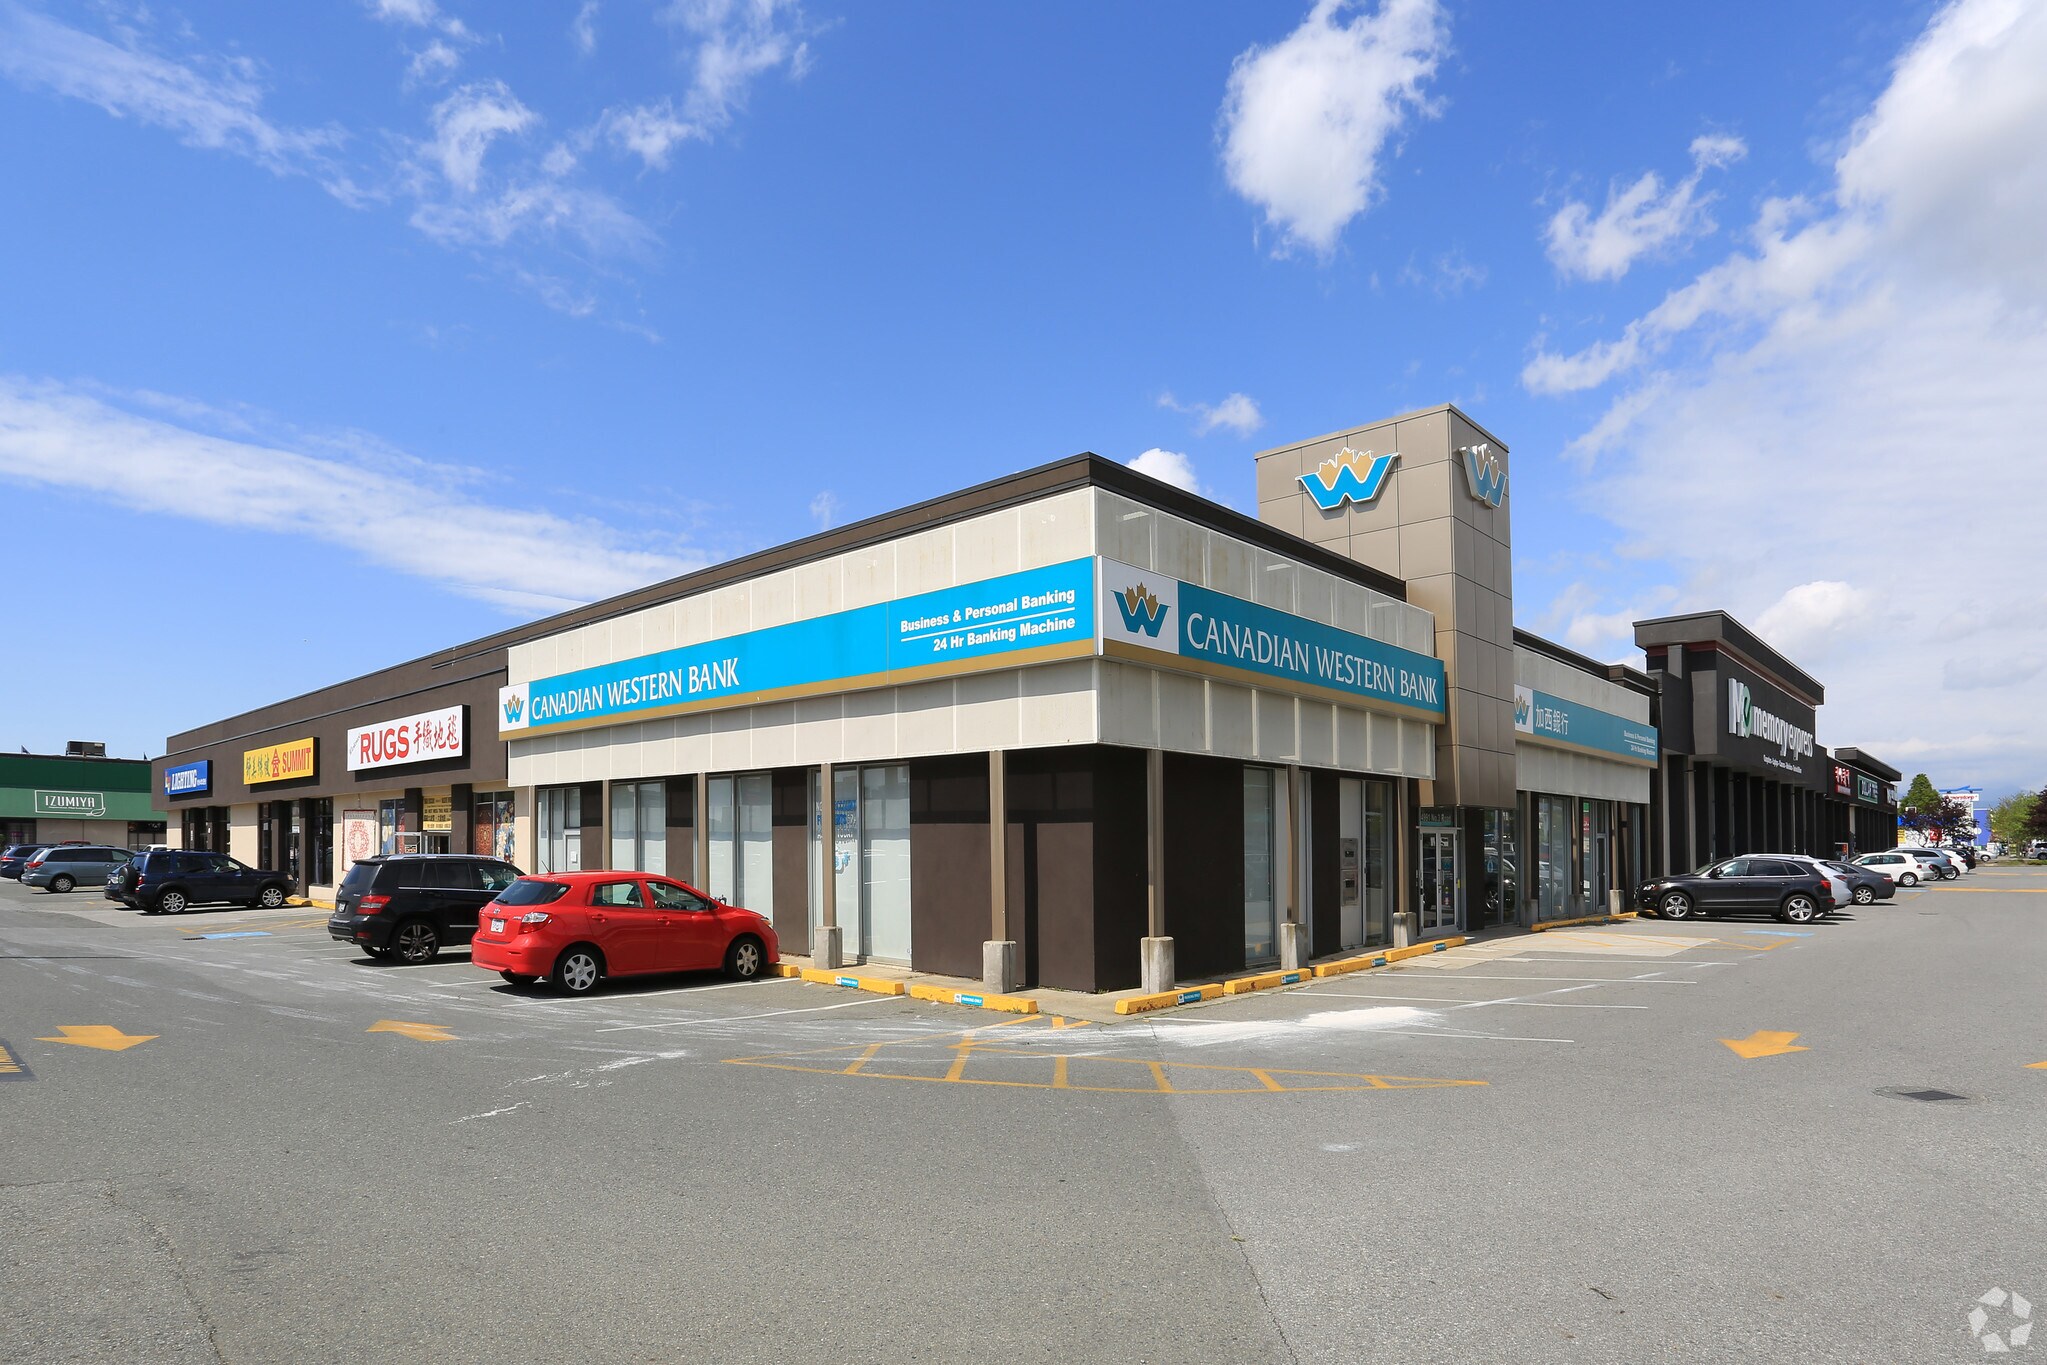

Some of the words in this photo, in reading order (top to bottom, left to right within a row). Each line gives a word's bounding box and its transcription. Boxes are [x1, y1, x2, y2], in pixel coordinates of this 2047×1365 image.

[901, 613, 949, 633] Business
[952, 609, 962, 623] &
[965, 598, 1017, 621] Personal
[1021, 588, 1075, 610] Banking
[933, 637, 948, 652] 24
[950, 635, 964, 649] Hr
[967, 626, 1016, 646] Banking
[1019, 616, 1076, 637] Machine
[1186, 612, 1310, 675] CANADIAN
[1315, 645, 1395, 695] WESTERN
[1400, 669, 1438, 705] BANK
[532, 684, 604, 720] CANADIAN
[607, 668, 682, 707] WESTERN
[688, 657, 740, 694] BANK
[1536, 704, 1569, 735] 加西銀行
[282, 747, 311, 773] SUMMIT
[360, 725, 410, 764] RUGS
[171, 769, 197, 790] LIGHTING
[45, 795, 95, 808] IZUMIYA
